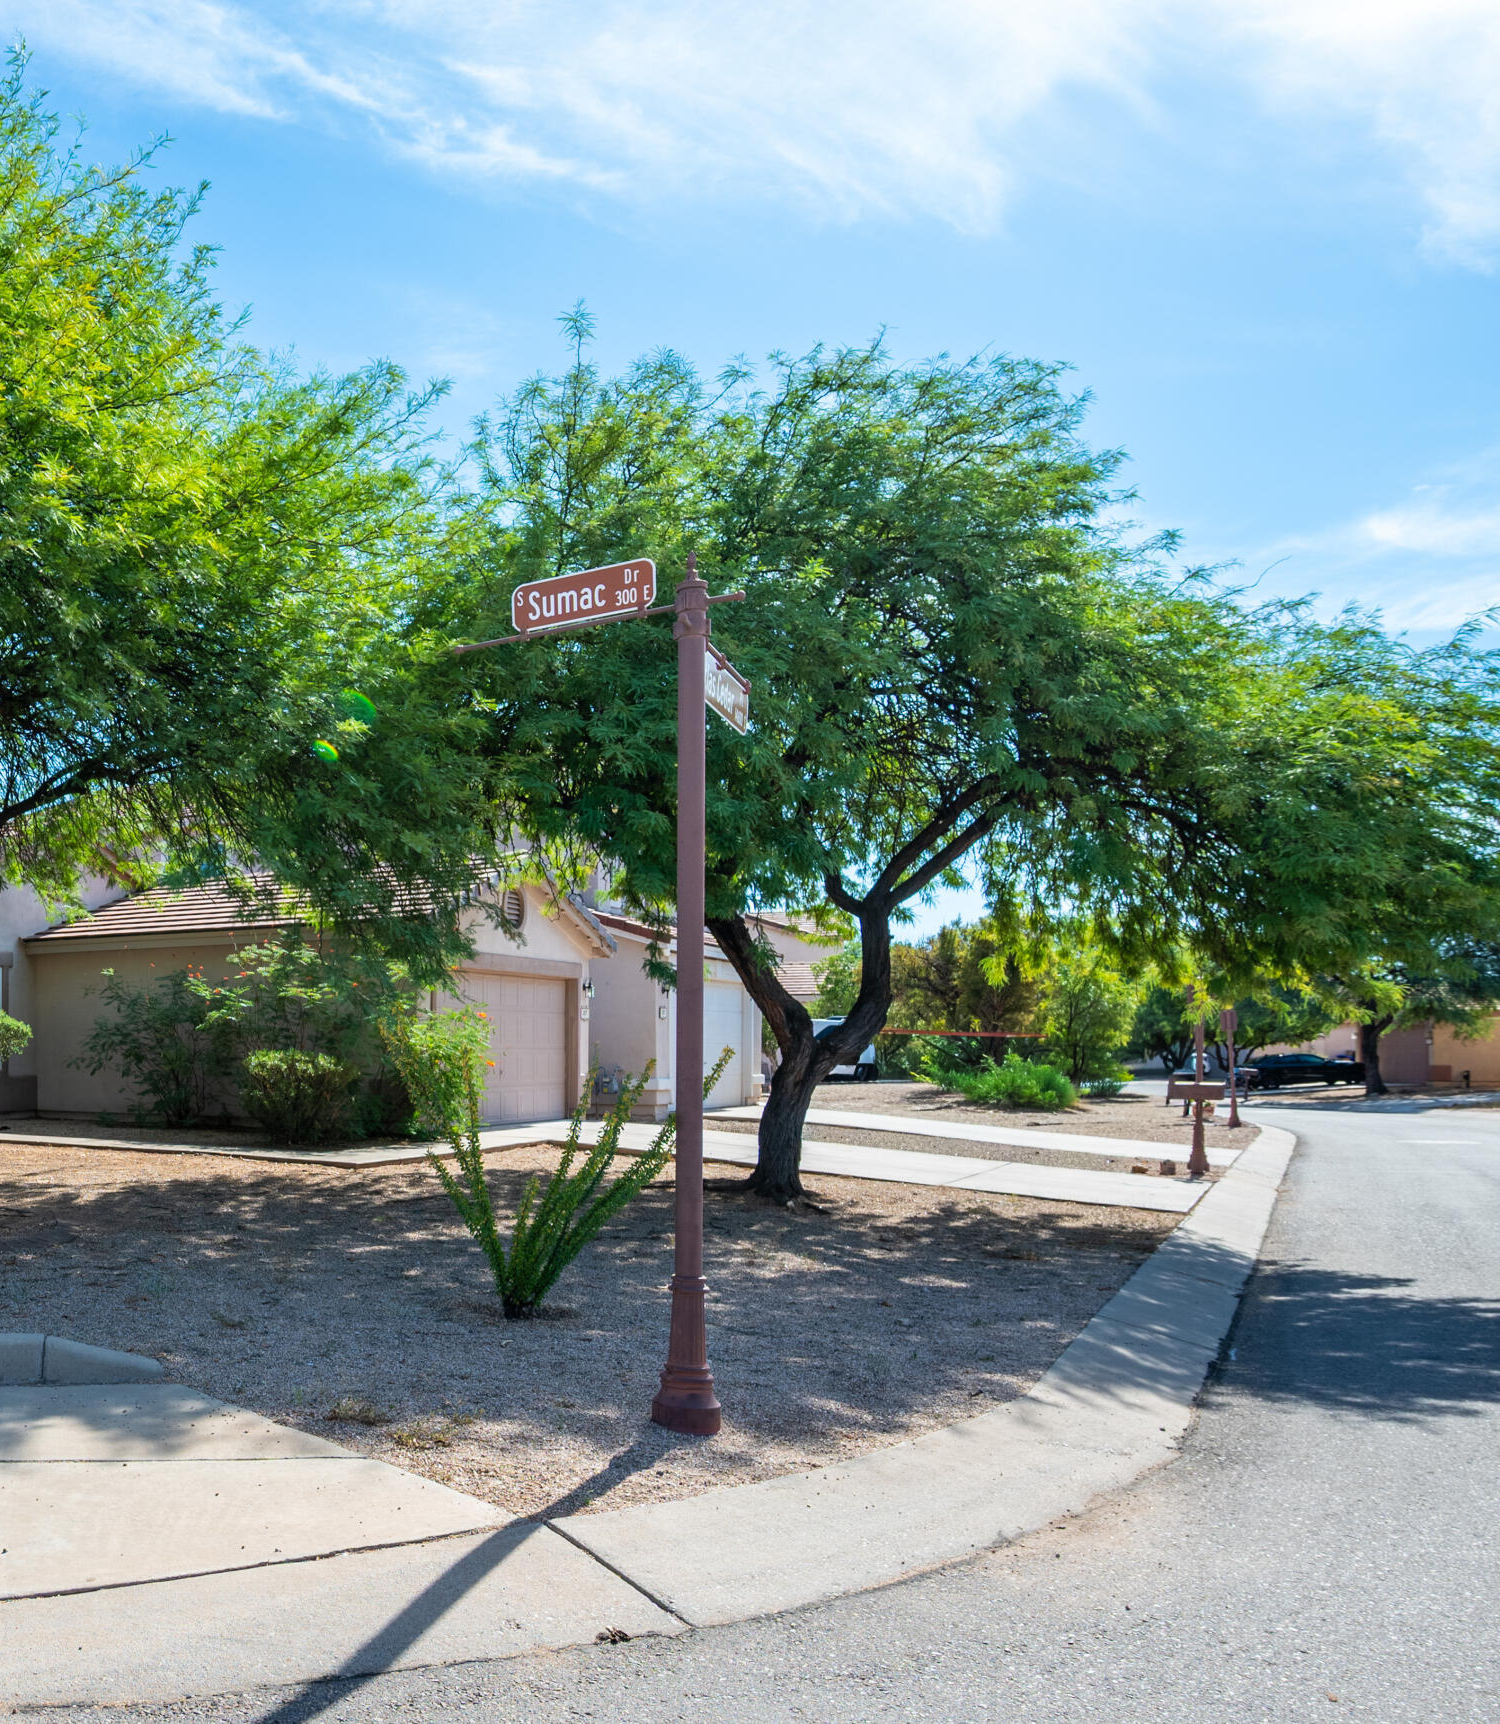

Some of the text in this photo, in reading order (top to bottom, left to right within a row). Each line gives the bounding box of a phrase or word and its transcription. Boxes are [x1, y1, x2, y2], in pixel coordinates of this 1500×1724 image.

[624, 568, 640, 584] Dr
[516, 584, 606, 620] S Sumac
[615, 584, 651, 606] 300 E
